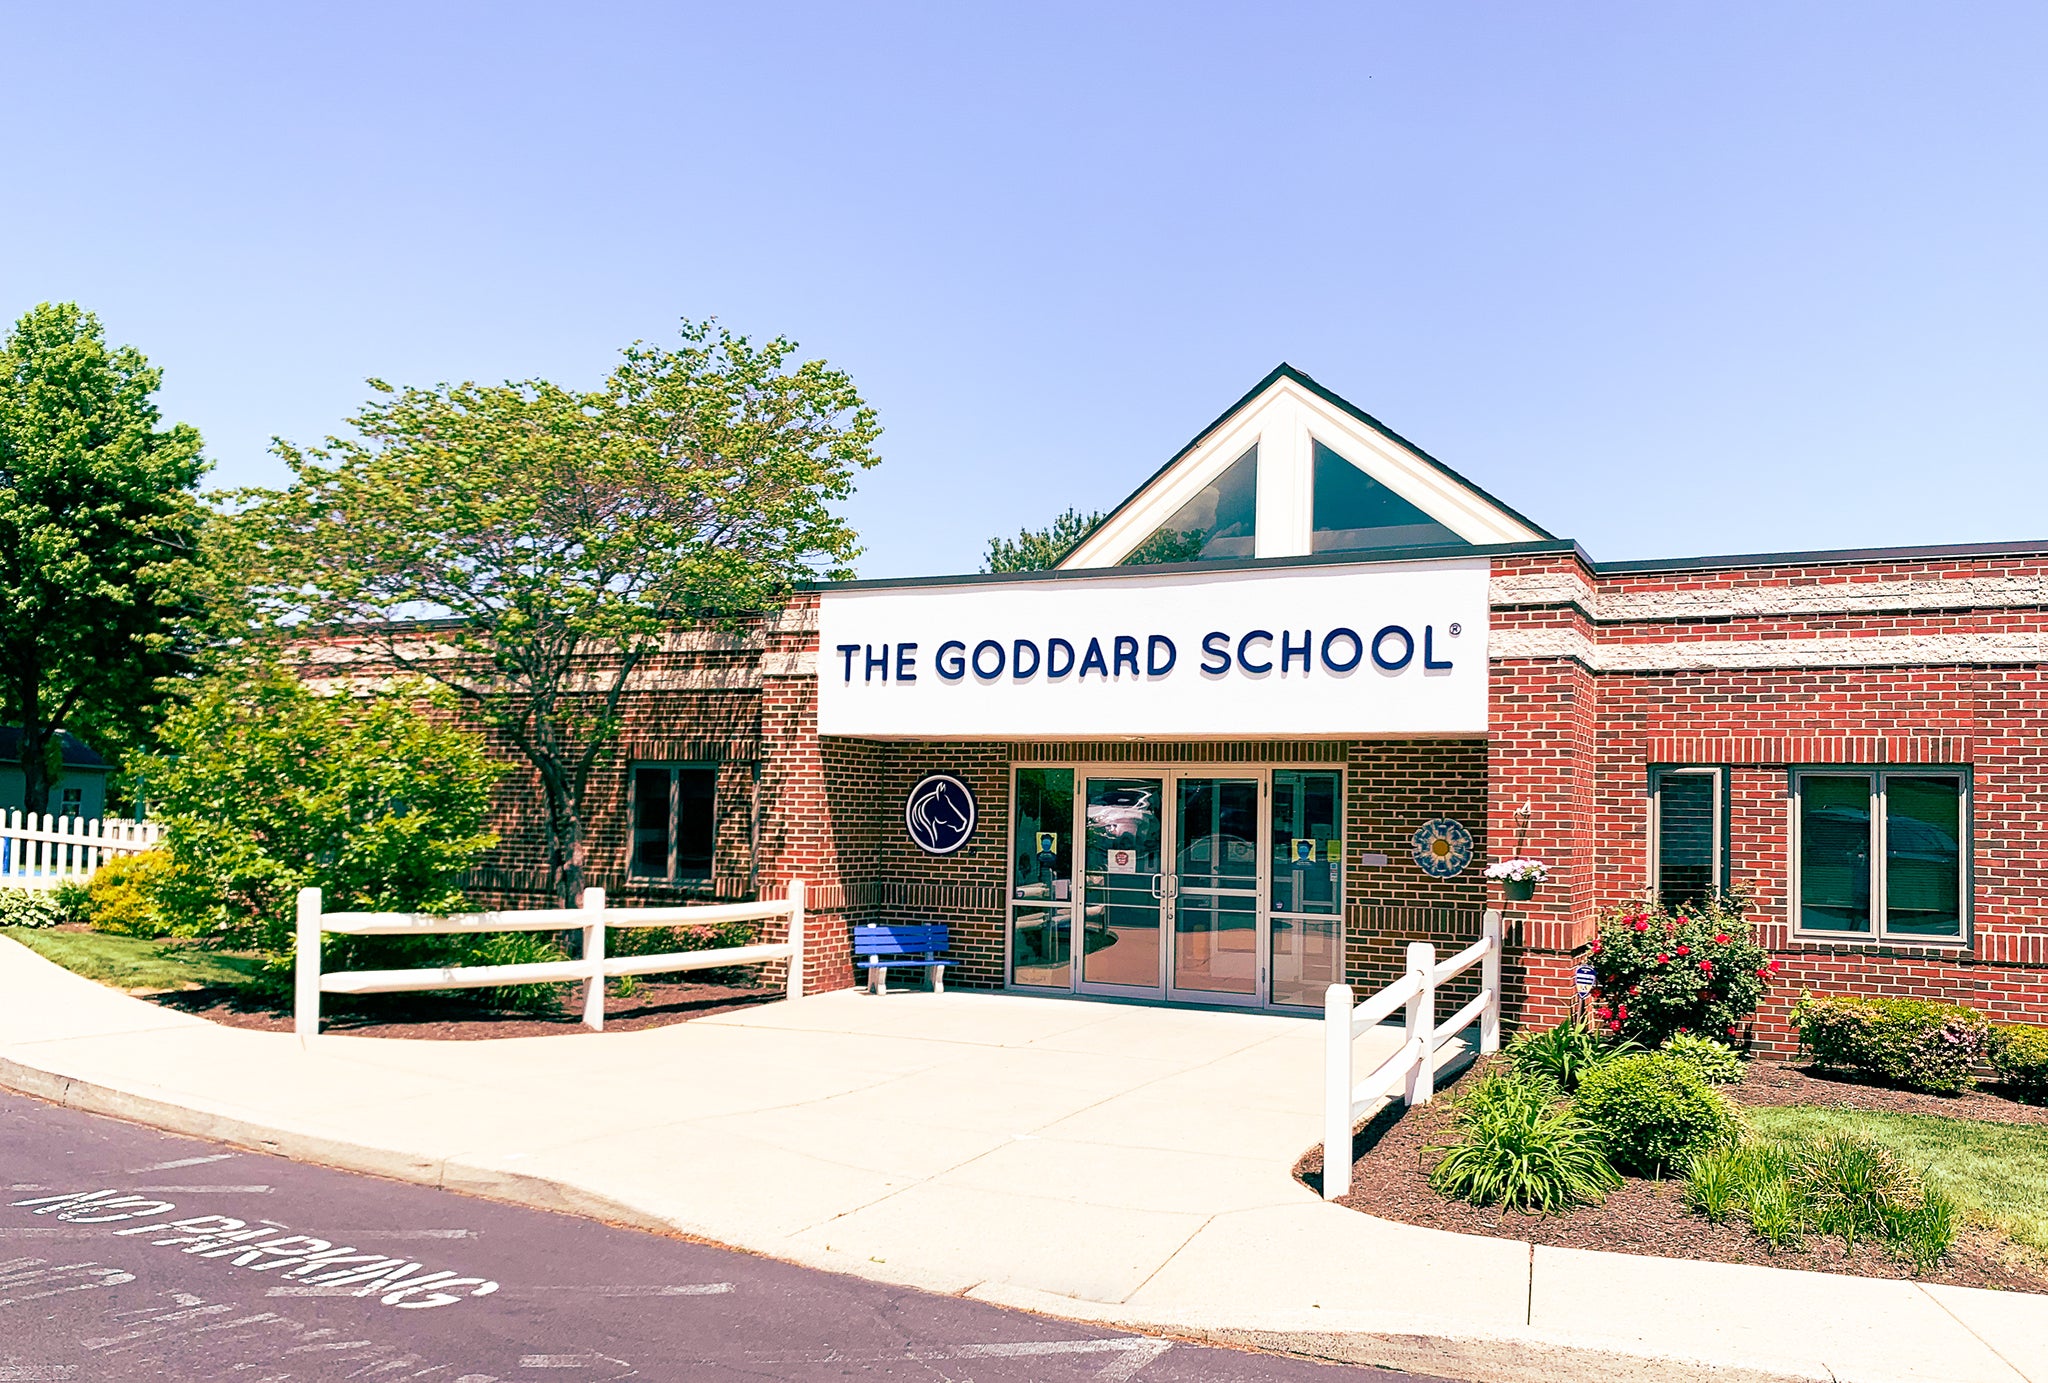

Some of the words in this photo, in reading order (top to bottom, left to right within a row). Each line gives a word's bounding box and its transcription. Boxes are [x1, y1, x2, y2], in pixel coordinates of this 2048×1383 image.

[837, 643, 918, 682] THE
[935, 635, 1177, 681] GODDARD
[10, 1189, 176, 1223] NO
[112, 1214, 500, 1309] PARKING
